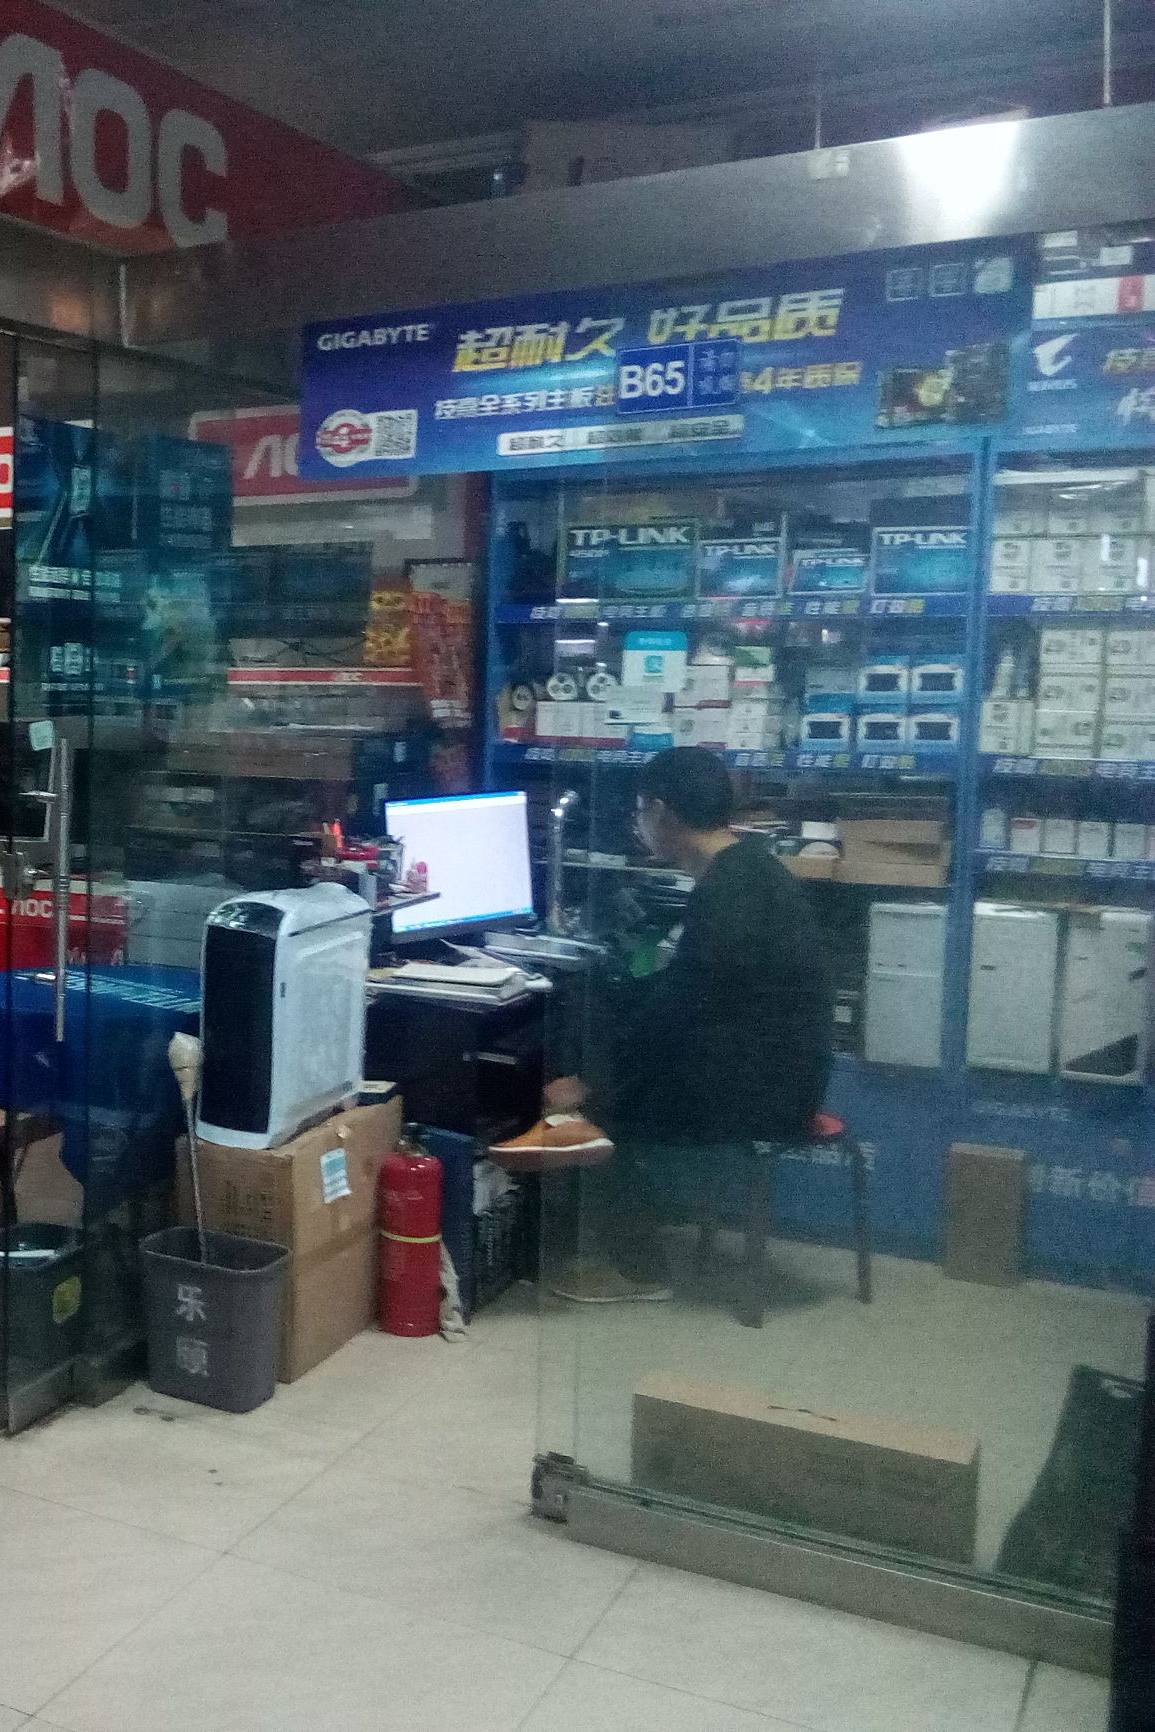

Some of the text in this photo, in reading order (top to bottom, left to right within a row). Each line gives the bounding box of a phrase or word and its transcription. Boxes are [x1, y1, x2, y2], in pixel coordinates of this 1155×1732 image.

[648, 287, 845, 346] 好品质
[316, 323, 431, 351] GIGABYTE
[451, 317, 626, 373] 超耐久
[619, 360, 686, 400] B65
[570, 526, 692, 547] TP-LINK
[878, 531, 968, 546] TP-LINK
